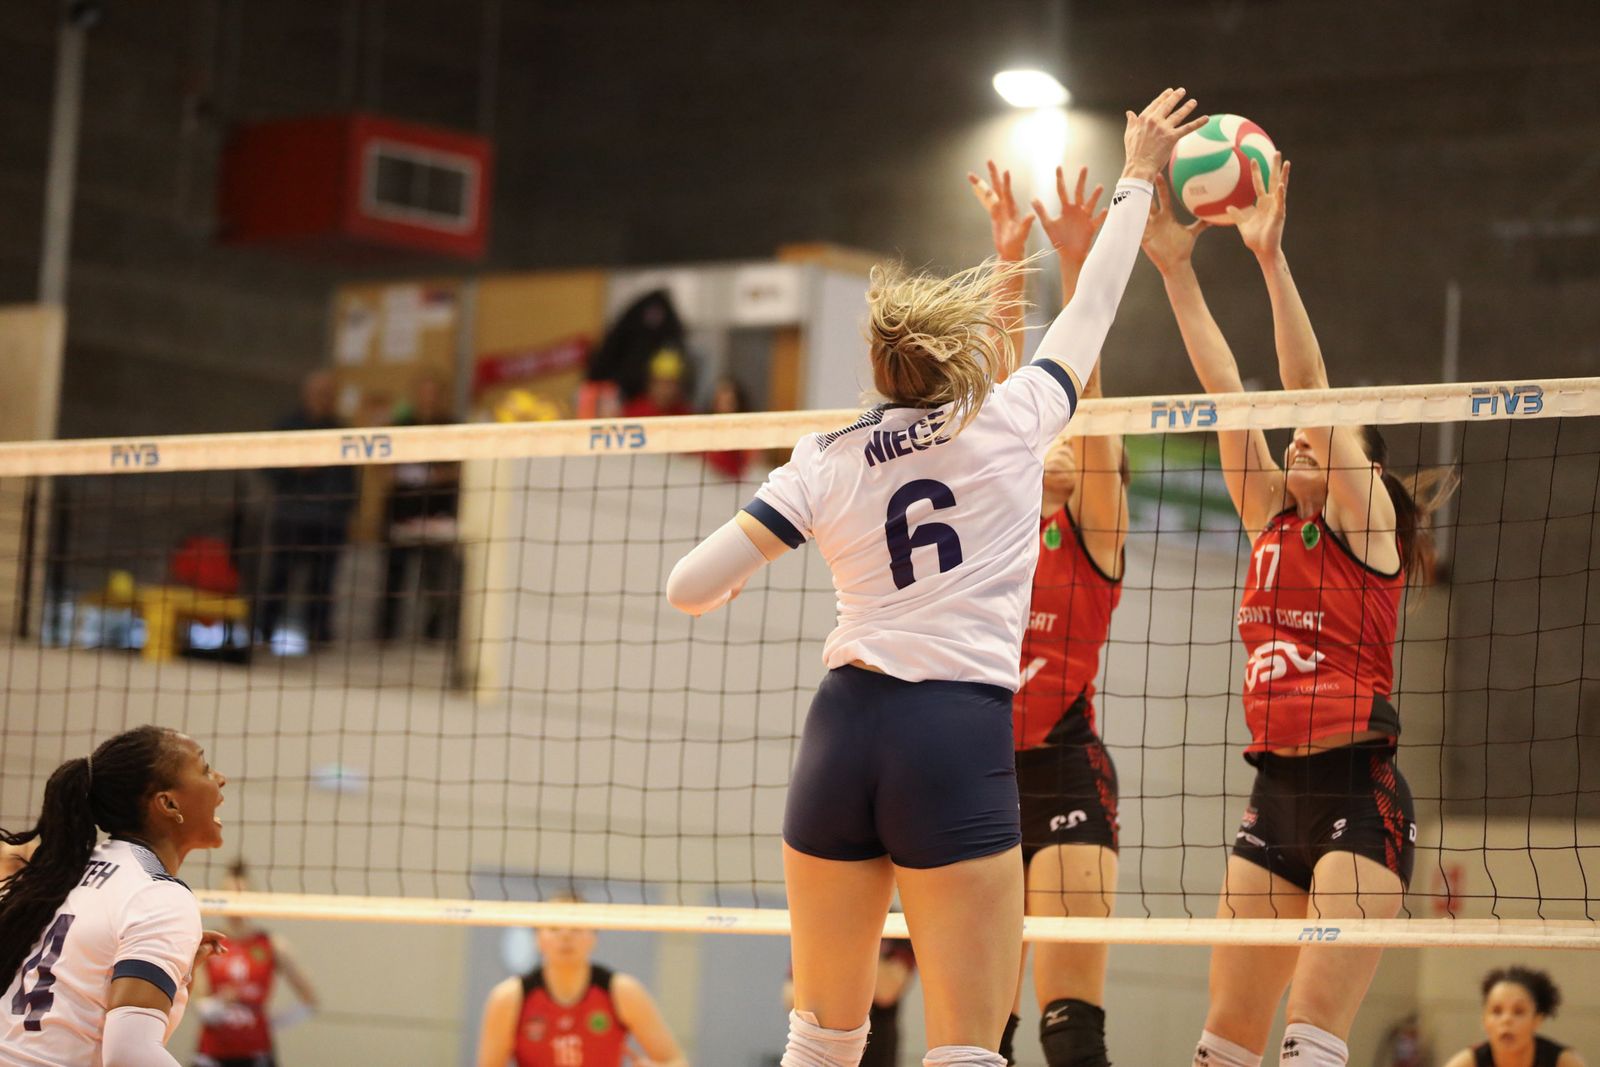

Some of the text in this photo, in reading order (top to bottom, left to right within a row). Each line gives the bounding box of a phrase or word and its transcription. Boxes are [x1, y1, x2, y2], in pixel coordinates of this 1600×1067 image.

[1150, 400, 1219, 429] FIVB
[1470, 385, 1544, 416] FIVB
[885, 478, 963, 590] 6
[1254, 543, 1281, 592] 17
[1237, 606, 1325, 632] SANT CUGAT
[11, 913, 76, 1032] 4
